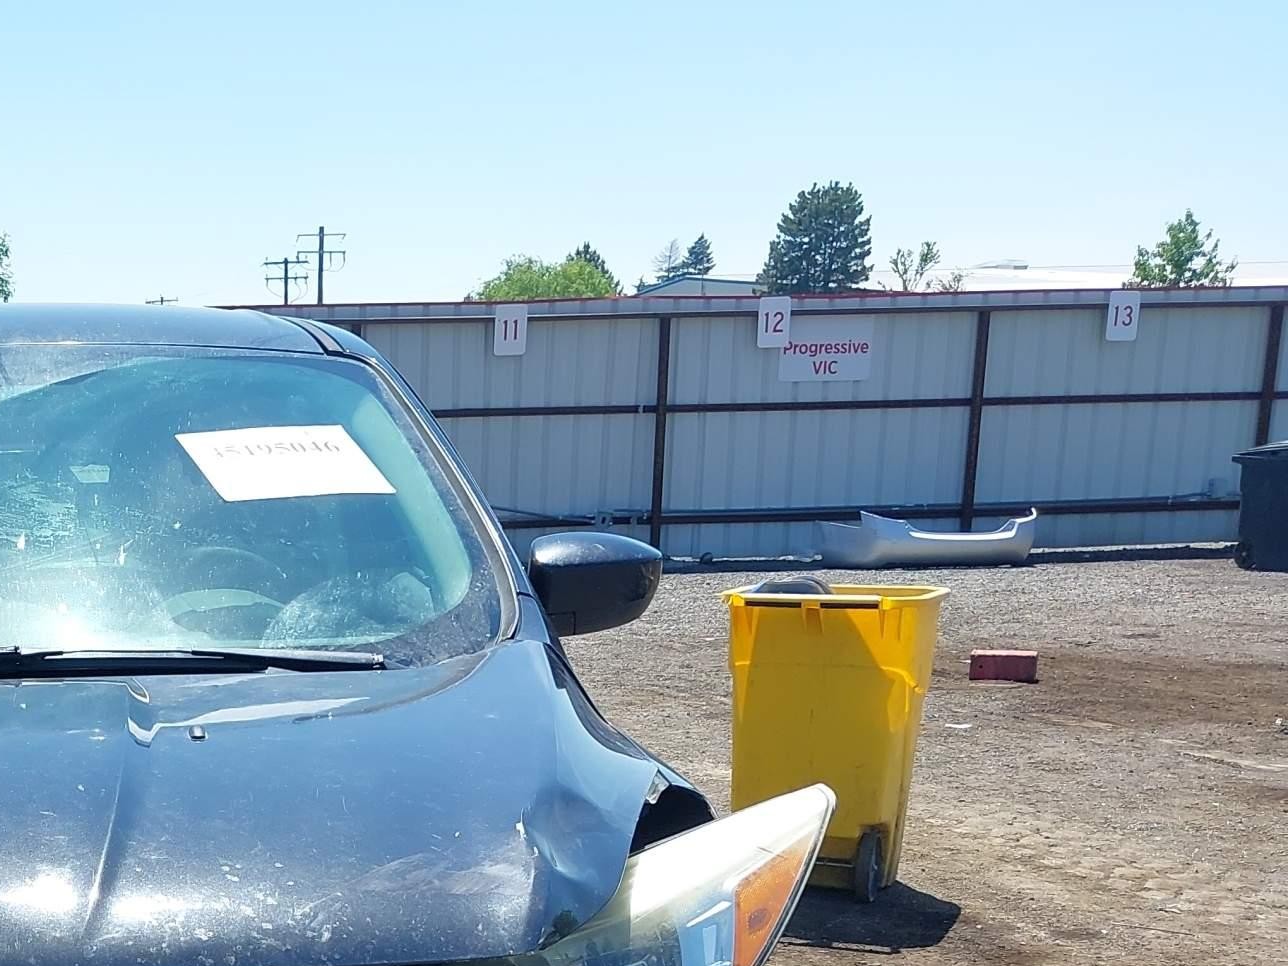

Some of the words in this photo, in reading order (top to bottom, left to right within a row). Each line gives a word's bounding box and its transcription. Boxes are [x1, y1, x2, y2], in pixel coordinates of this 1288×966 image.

[764, 311, 785, 334] 12
[1113, 305, 1134, 327] 13
[502, 318, 519, 342] 11
[783, 340, 869, 358] Progressive
[812, 360, 839, 375] VIC
